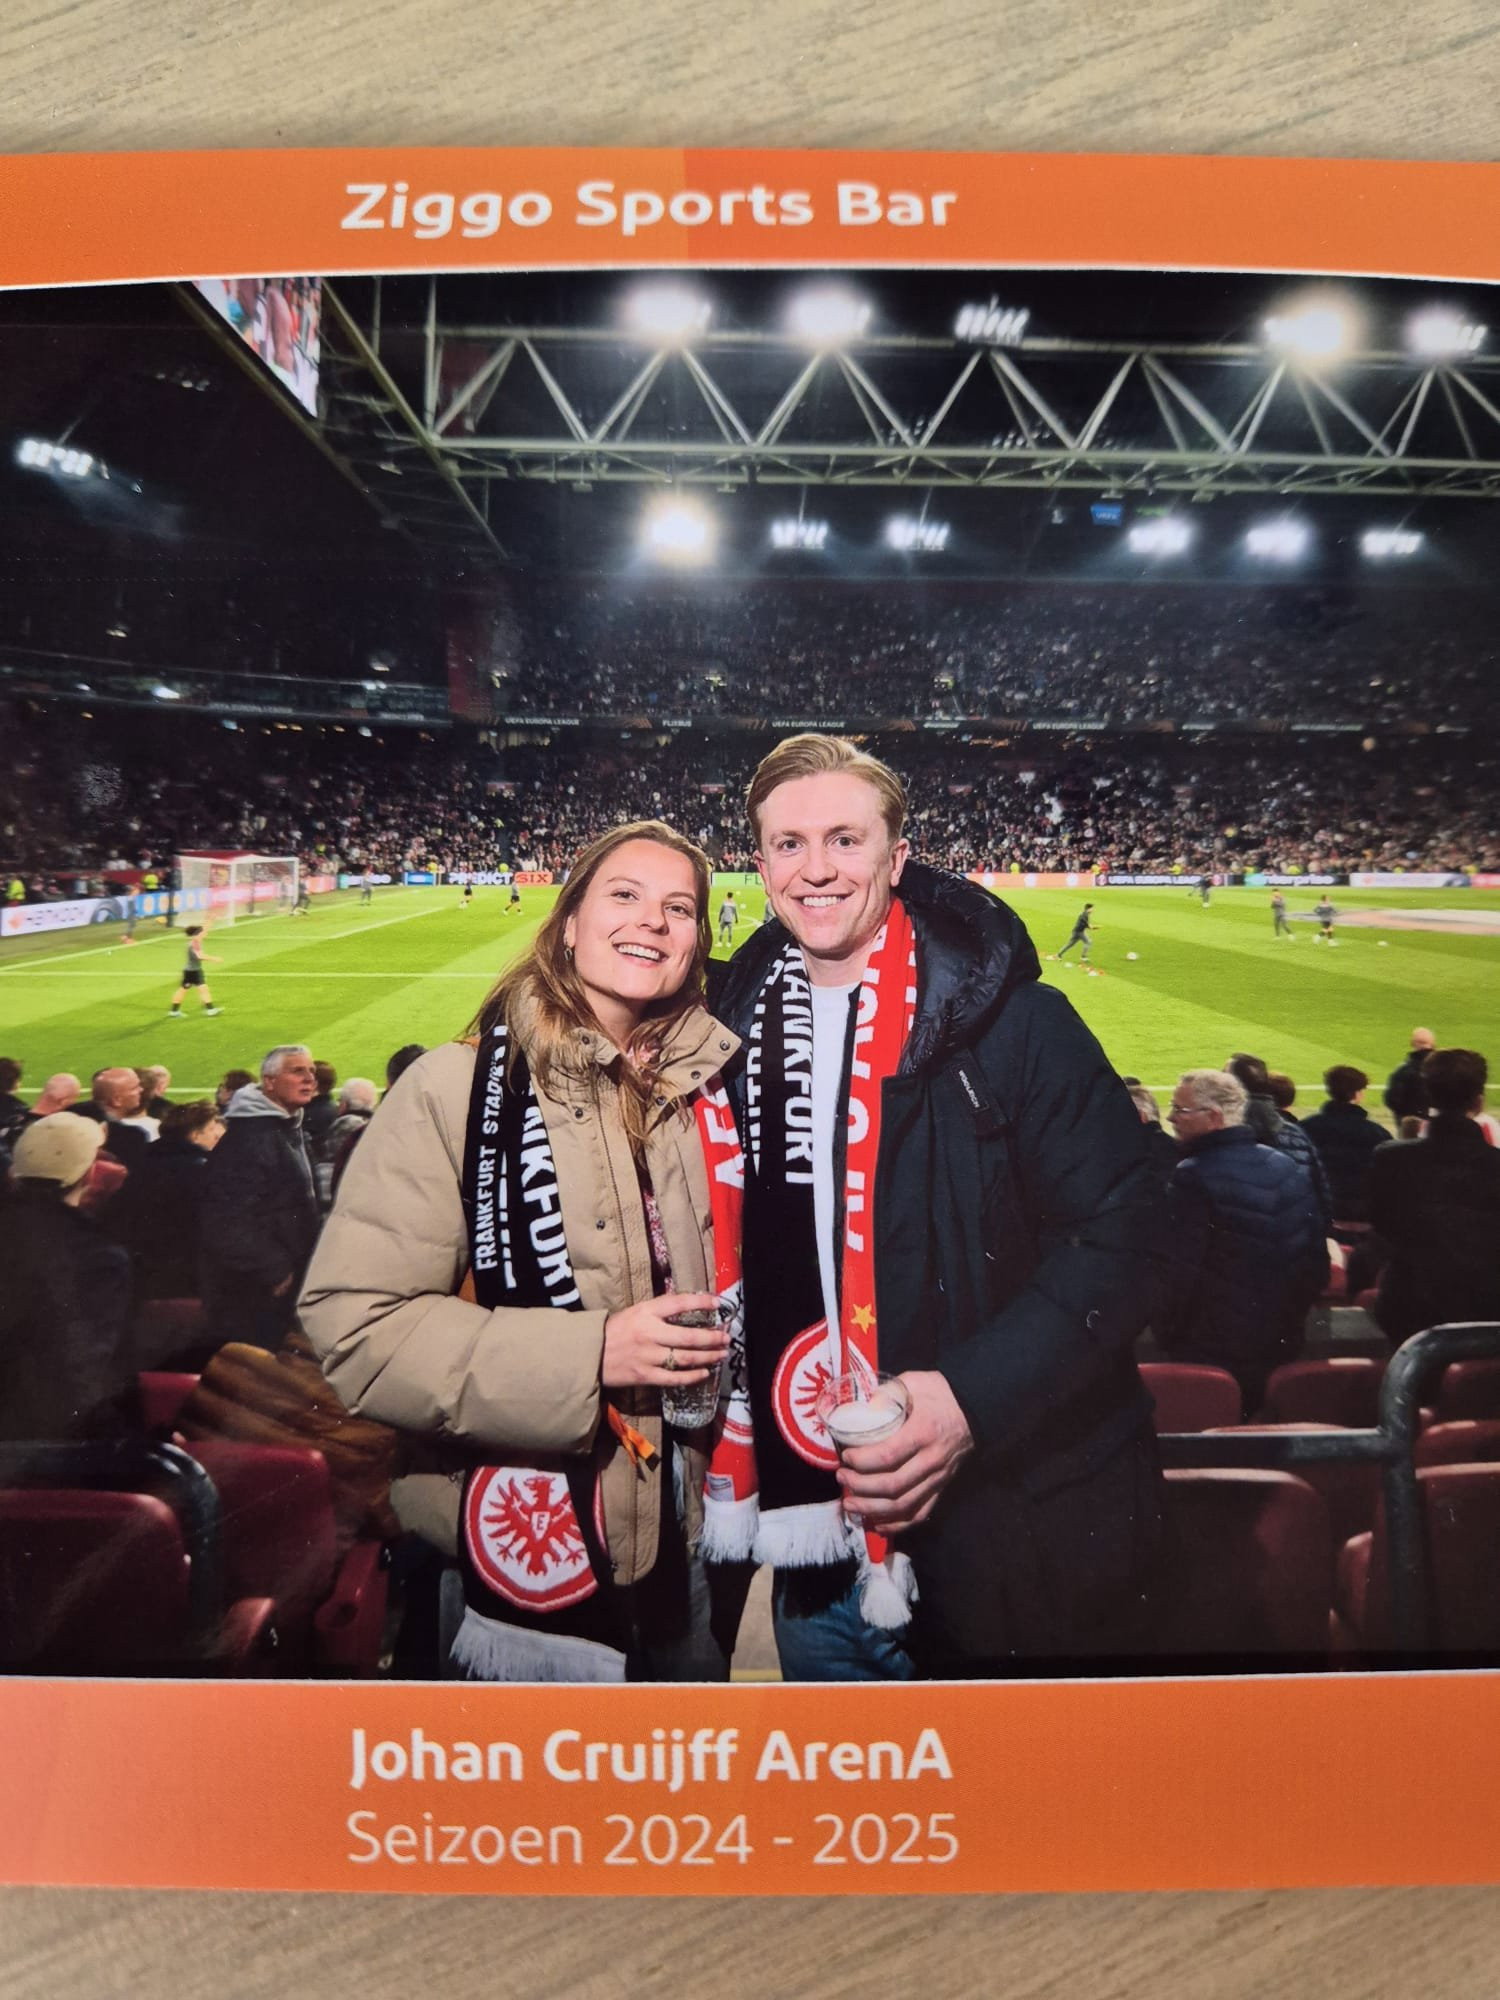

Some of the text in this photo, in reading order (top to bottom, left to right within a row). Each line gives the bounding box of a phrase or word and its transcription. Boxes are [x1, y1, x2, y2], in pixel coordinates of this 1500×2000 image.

[340, 180, 957, 240] Ziggo Sports Bar
[516, 873, 549, 884] SIX
[781, 944, 815, 1184] RANKFURT
[474, 1145, 499, 1272] FRANKFURT
[348, 1727, 954, 1793] Johan Cruijff ArenA
[346, 1810, 960, 1865] Seizoen 2024 - 2025
